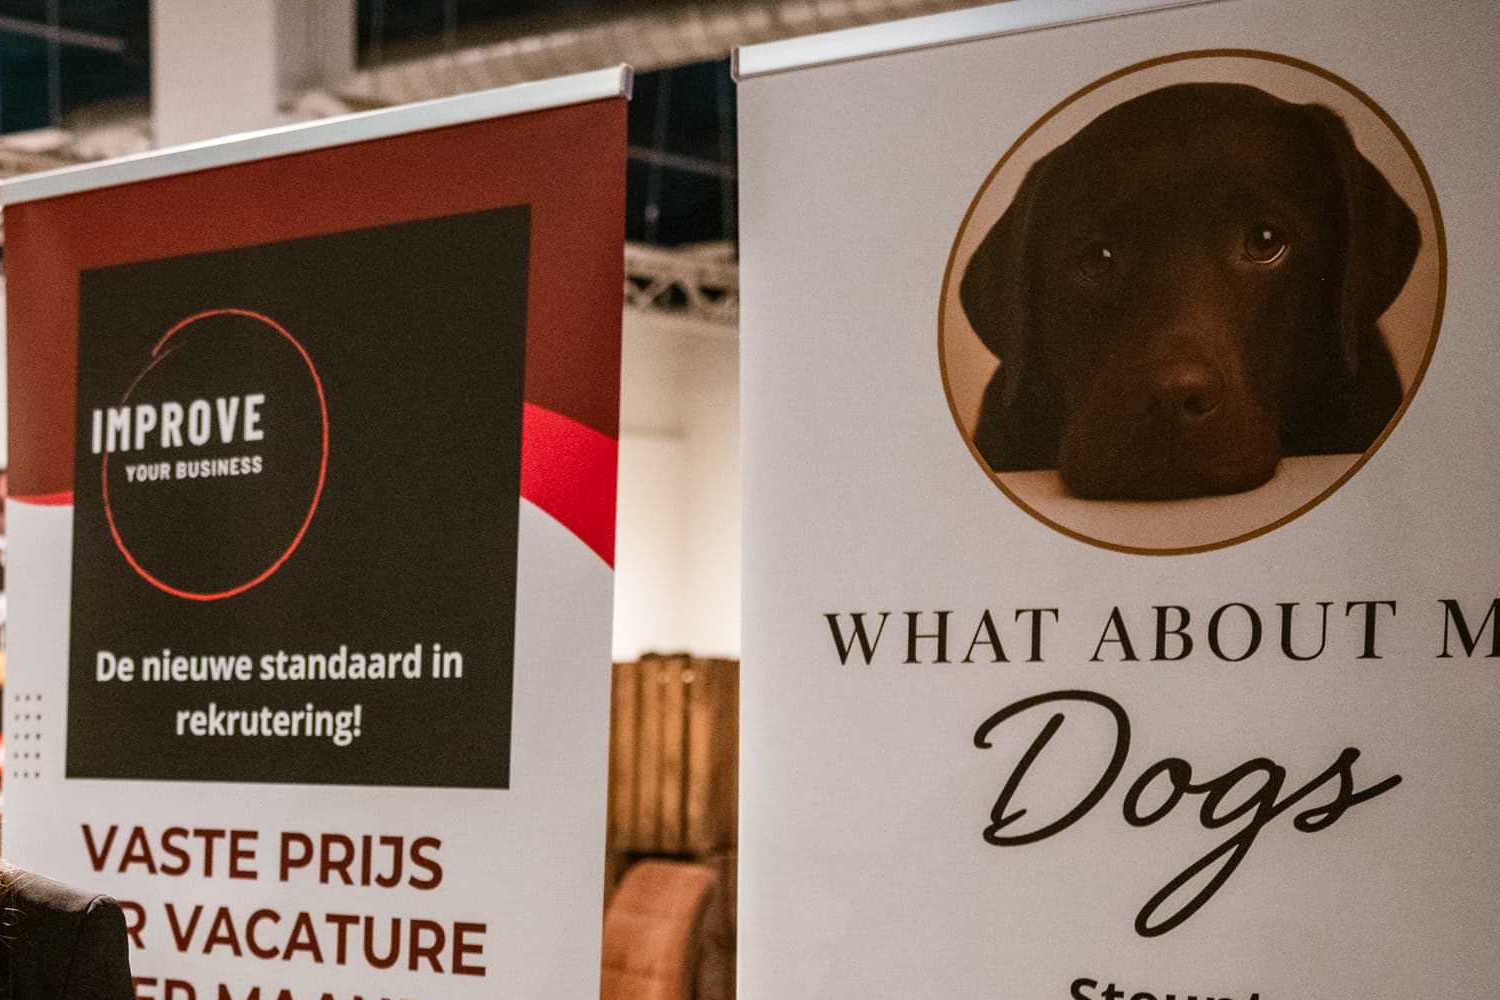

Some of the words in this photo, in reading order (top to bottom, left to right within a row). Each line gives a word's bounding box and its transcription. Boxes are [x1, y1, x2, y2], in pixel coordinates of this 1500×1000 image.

[92, 394, 265, 454] IMPROVE
[126, 461, 171, 482] YOUR
[176, 456, 263, 480] BUSINESS
[97, 651, 134, 682] De
[142, 649, 253, 681] nieuwe
[260, 644, 422, 680] standaard
[432, 643, 463, 678] in
[823, 607, 1059, 666] WHAT
[1090, 599, 1396, 662] ABOUT
[176, 703, 362, 745] rekrutering!
[973, 689, 1402, 938] Dogs
[81, 823, 259, 880] VASTE
[279, 832, 443, 890] PRIJS
[165, 903, 488, 977] VACATURE
